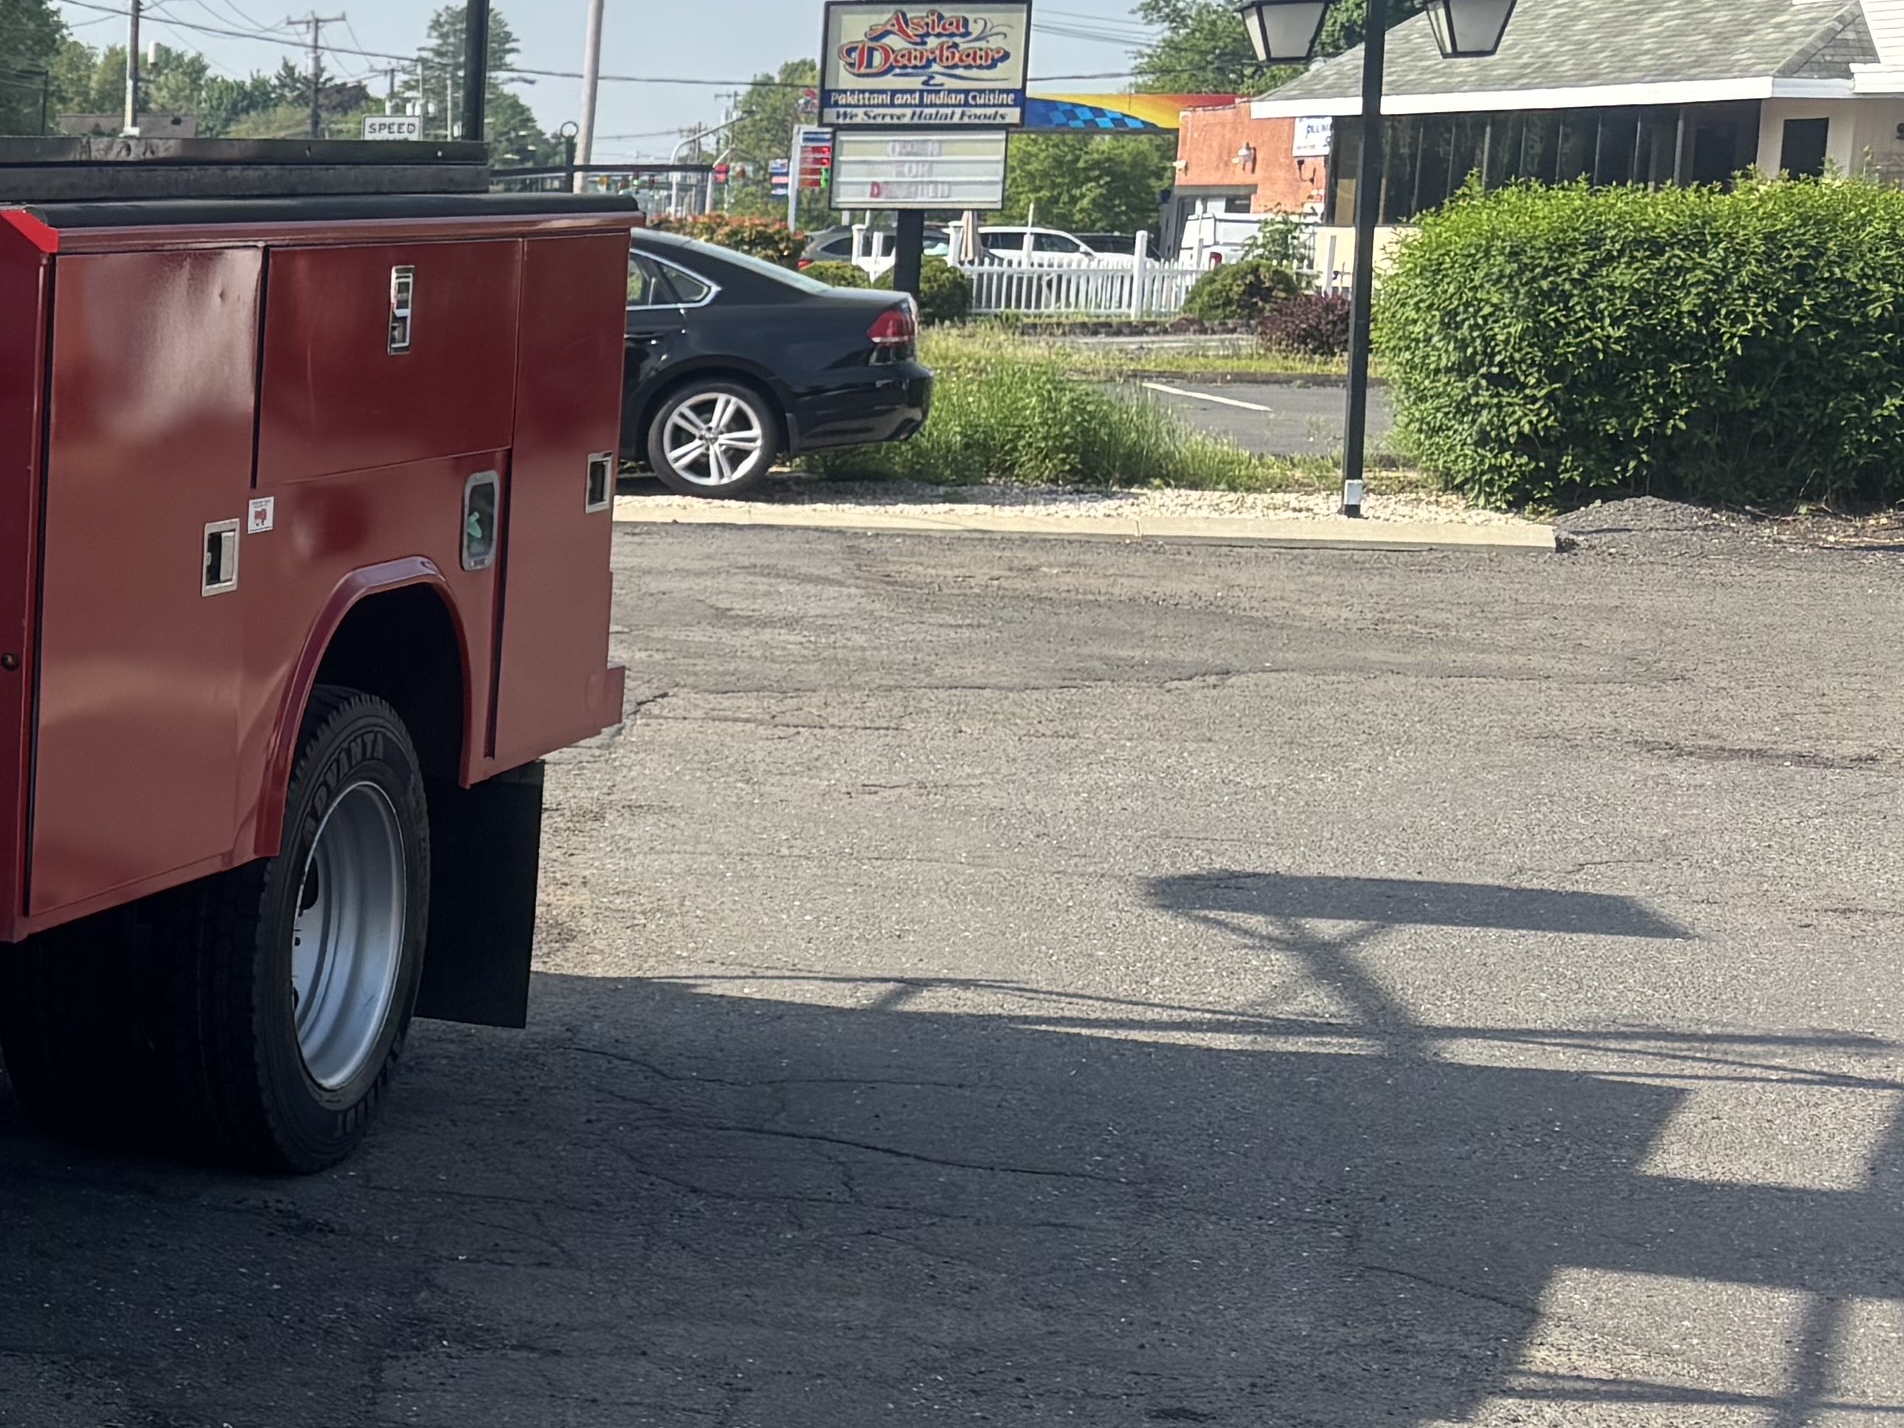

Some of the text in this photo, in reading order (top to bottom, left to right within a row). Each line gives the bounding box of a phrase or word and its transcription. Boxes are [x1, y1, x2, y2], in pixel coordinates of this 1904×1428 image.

[865, 9, 972, 45] Asia
[838, 40, 1011, 78] Darbar
[830, 91, 1015, 105] Pakistani and Indian Cuisine
[835, 110, 1008, 121] We Serve Halal Foods
[368, 122, 416, 134] SPEED
